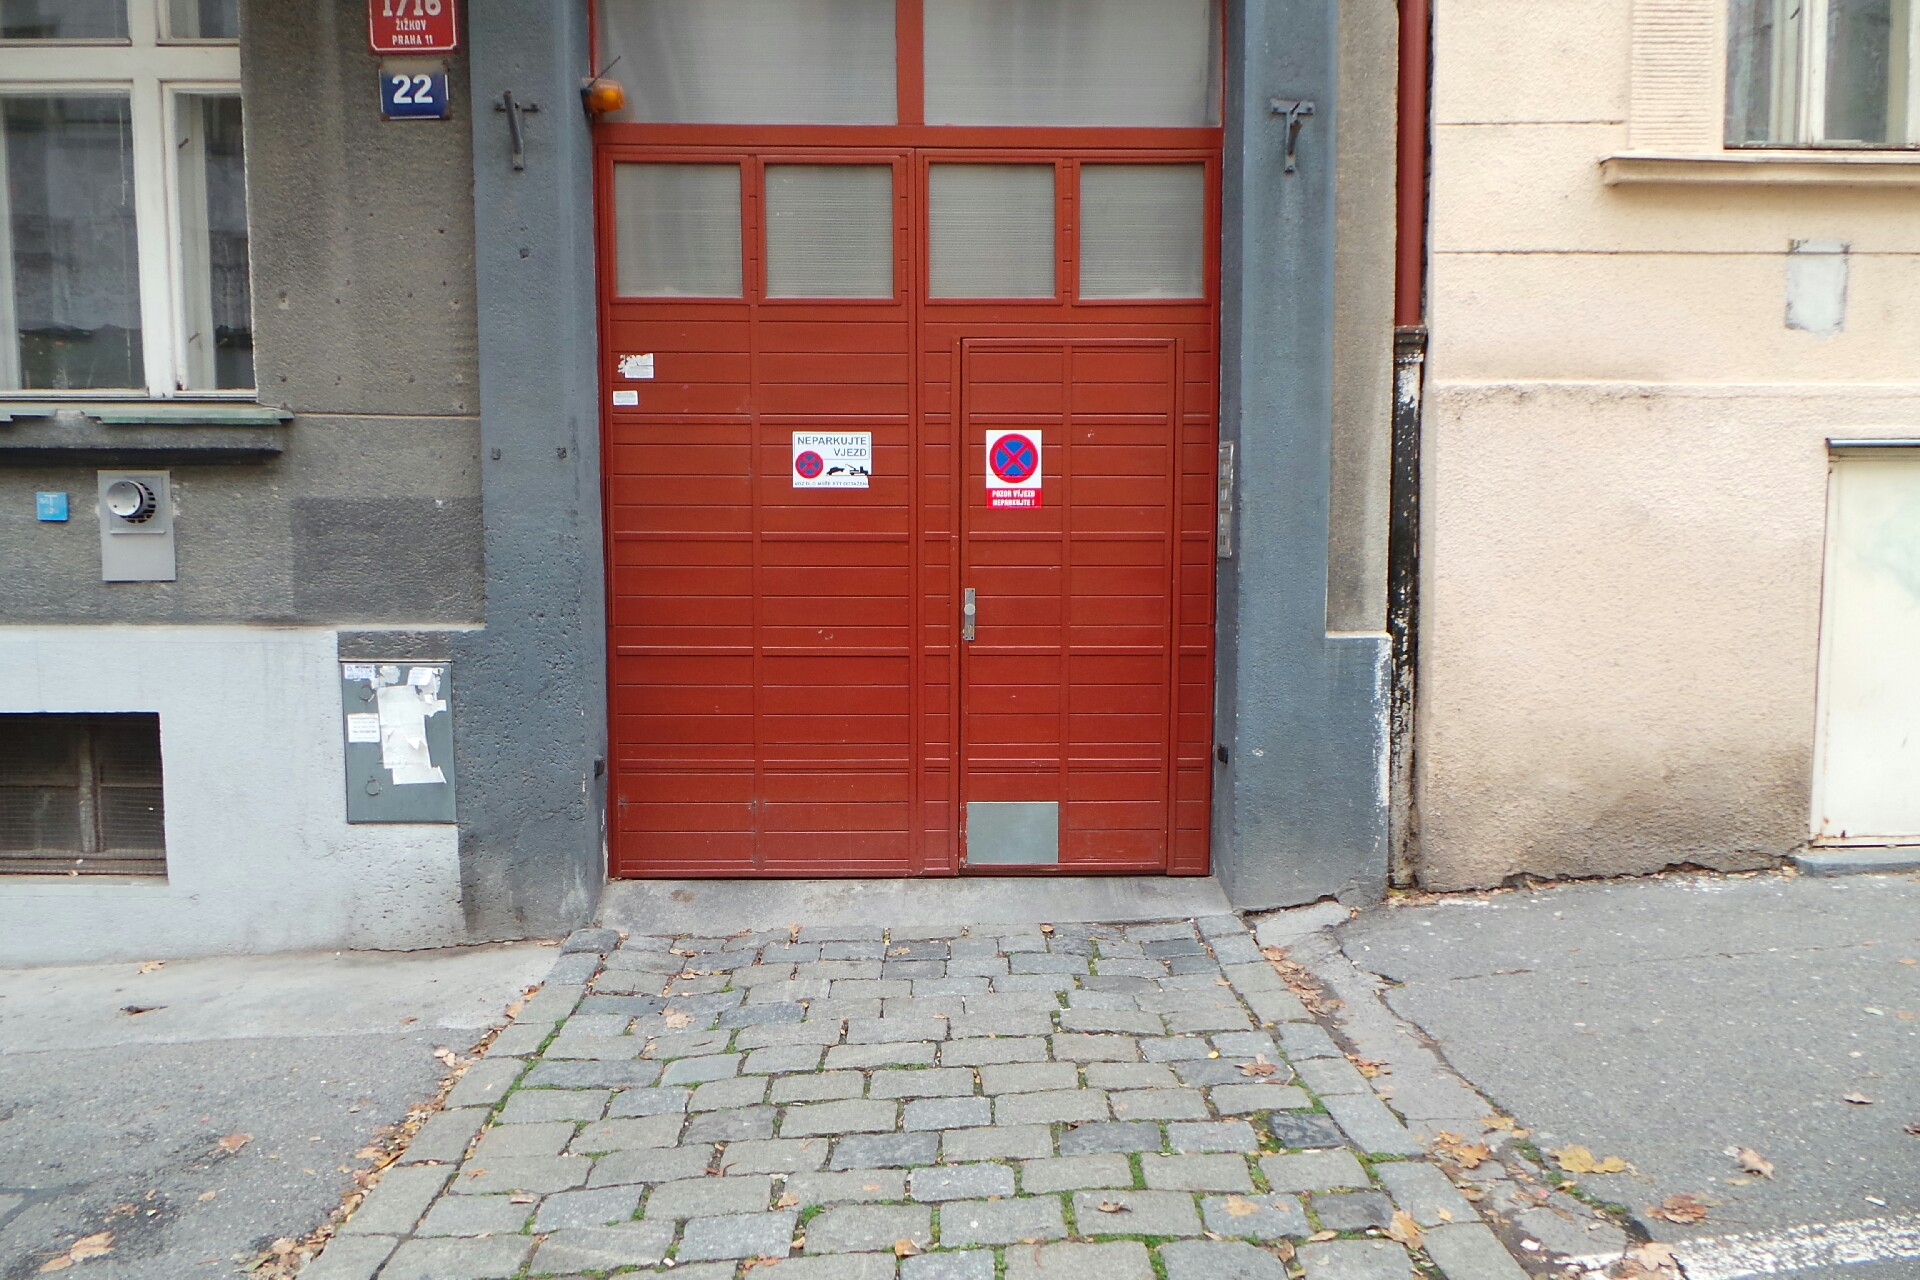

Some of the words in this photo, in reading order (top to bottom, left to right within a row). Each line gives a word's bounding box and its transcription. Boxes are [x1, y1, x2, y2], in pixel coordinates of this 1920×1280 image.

[383, 0, 441, 16] 1716
[396, 18, 426, 30] ŽIŽKOV
[392, 35, 422, 45] PRAHA
[425, 35, 433, 44] 11
[392, 74, 434, 104] 22
[797, 436, 866, 445] NEPARKUJTE
[834, 448, 866, 456] VJEZD
